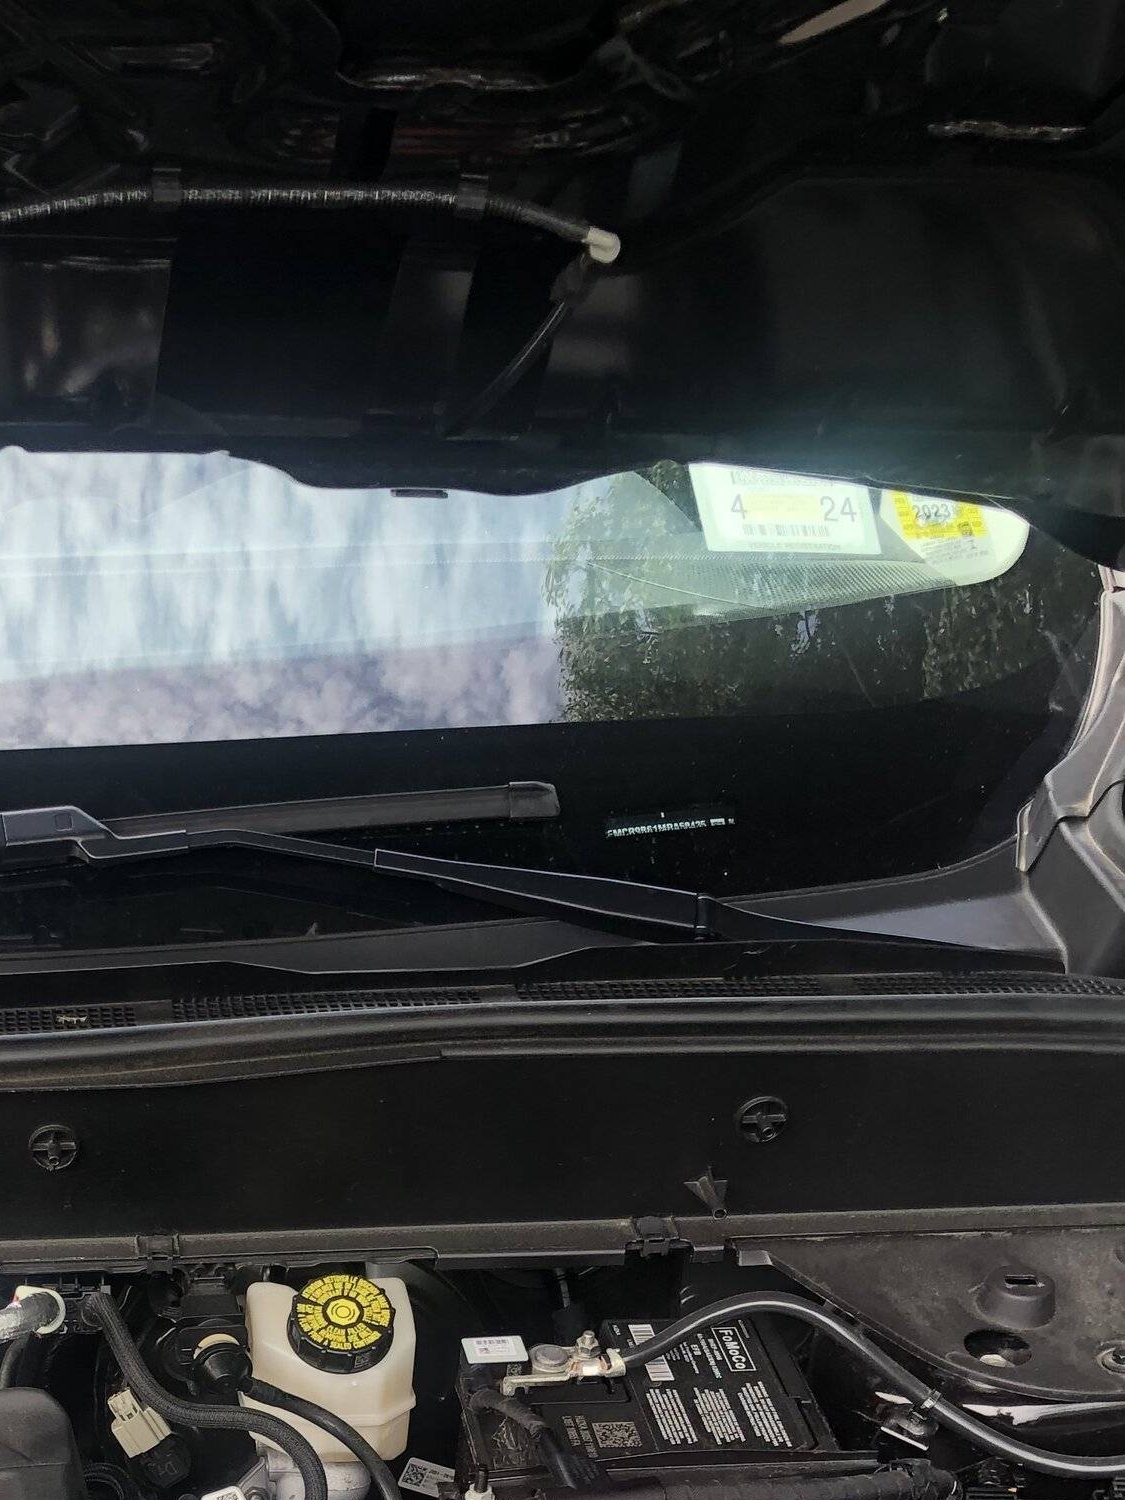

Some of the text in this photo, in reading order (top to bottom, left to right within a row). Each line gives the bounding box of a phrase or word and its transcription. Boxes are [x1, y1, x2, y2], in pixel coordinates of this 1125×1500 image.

[730, 493, 858, 523] 4 24
[912, 503, 952, 520] 2023
[718, 1329, 746, 1369] FoMoCo
